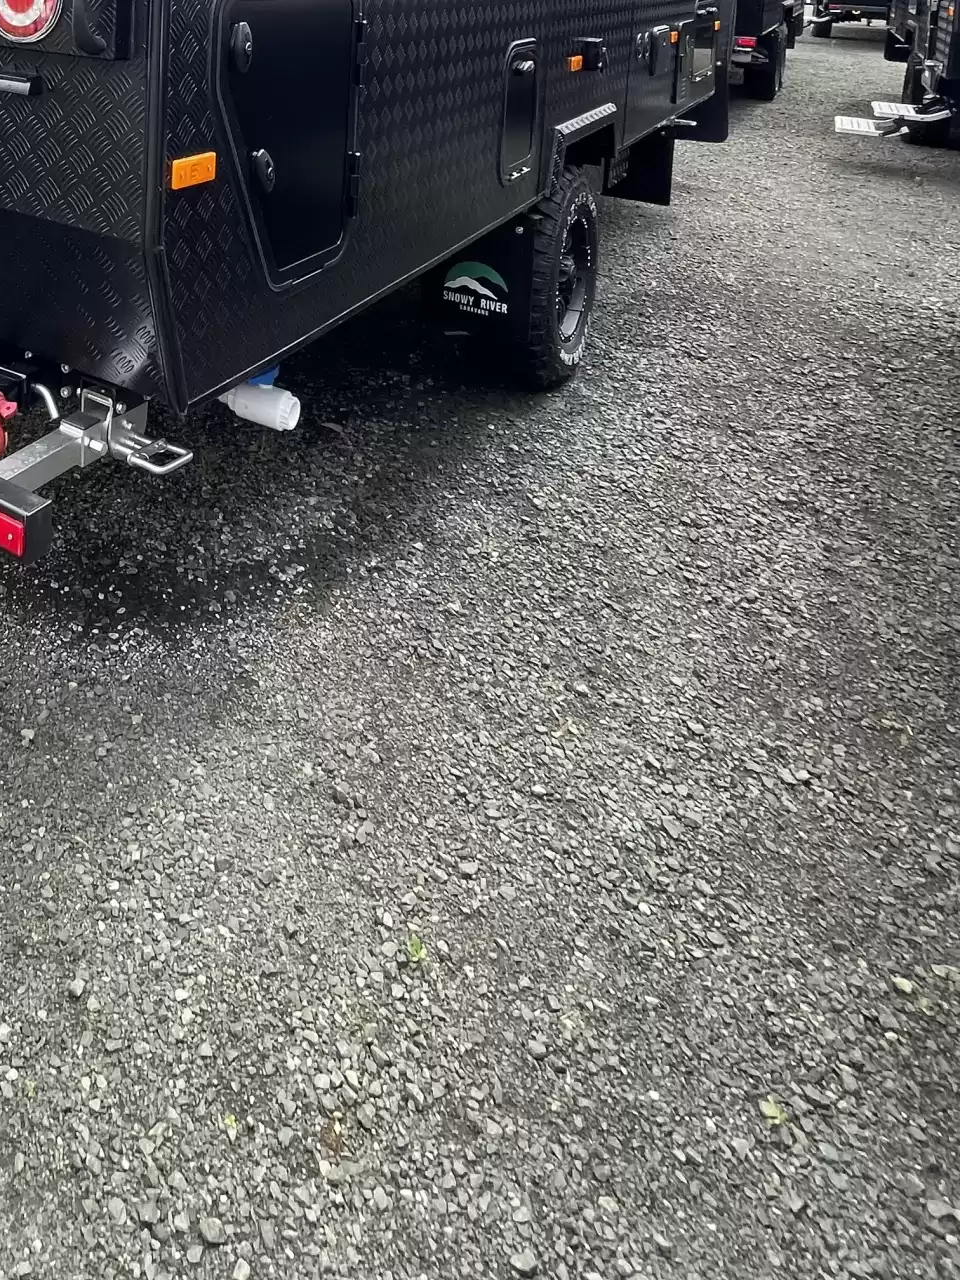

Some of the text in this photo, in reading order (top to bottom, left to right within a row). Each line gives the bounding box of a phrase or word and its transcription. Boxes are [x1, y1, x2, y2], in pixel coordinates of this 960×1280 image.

[443, 290, 508, 314] SNOWY RIVER
[459, 304, 489, 317] CARAVANS
